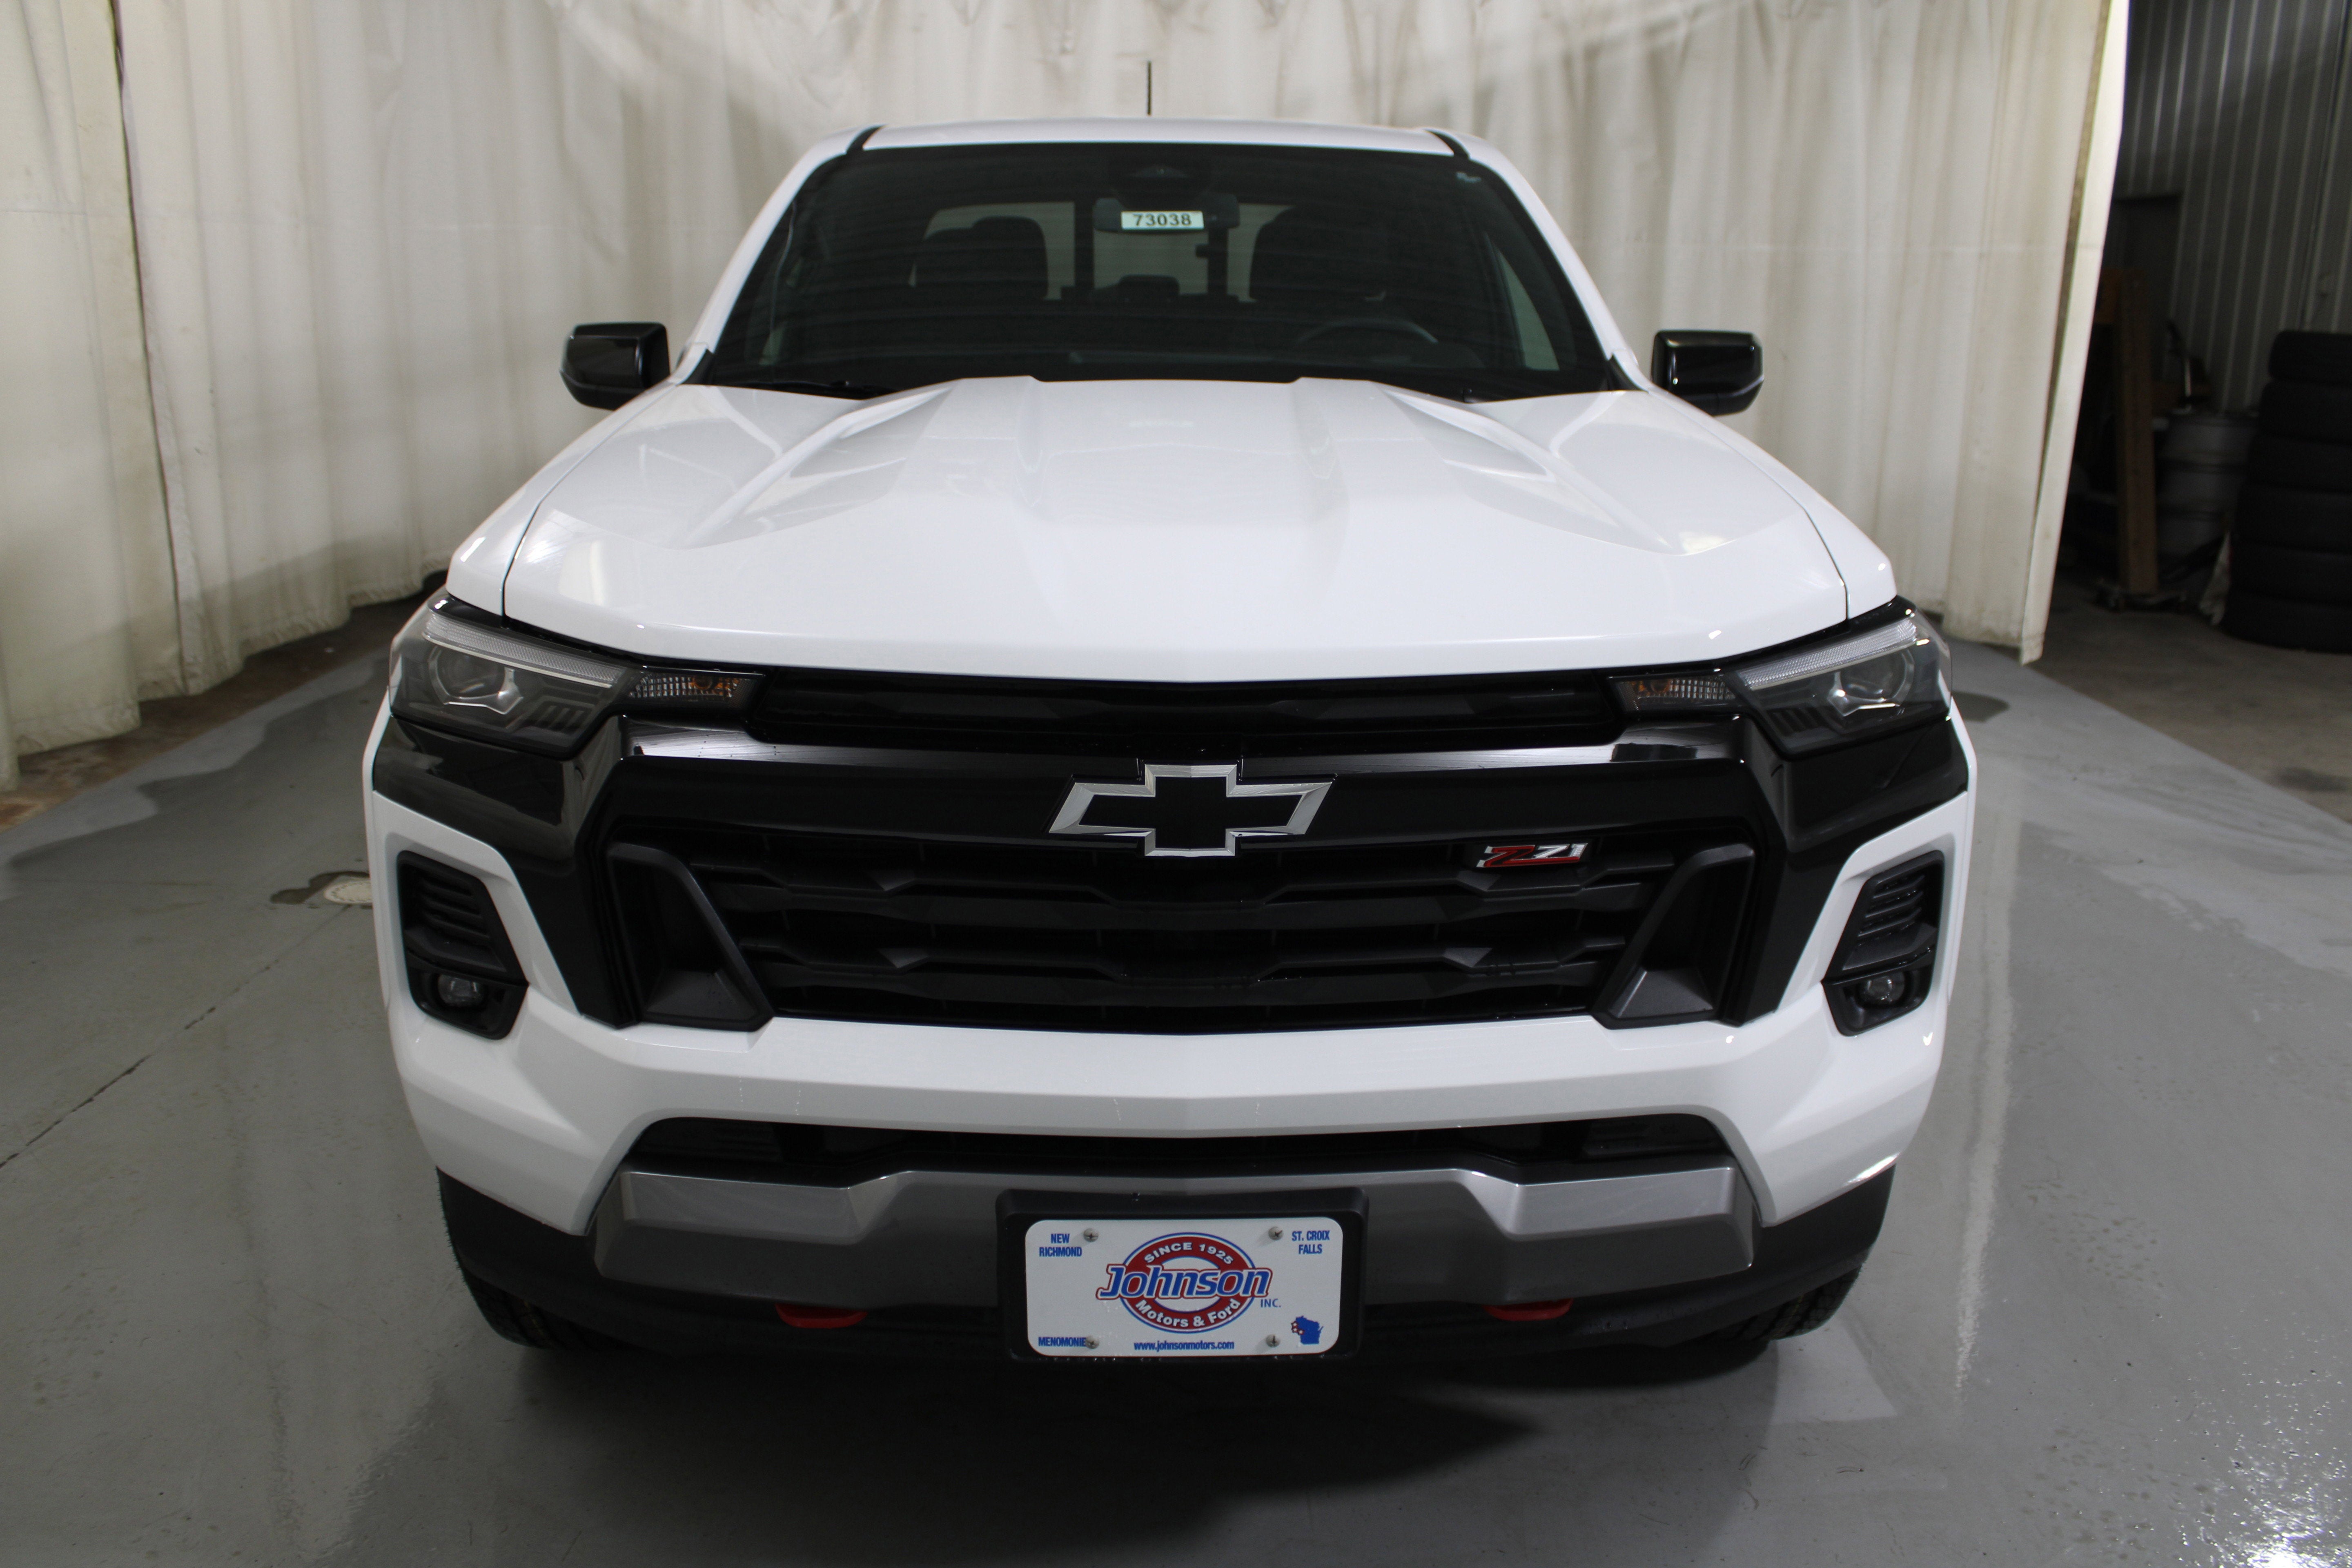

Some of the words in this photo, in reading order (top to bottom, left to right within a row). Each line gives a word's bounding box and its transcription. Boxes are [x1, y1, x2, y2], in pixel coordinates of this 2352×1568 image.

[1133, 212, 1192, 226] 73038
[1476, 843, 1588, 867] Z71
[1051, 1234, 1070, 1243] NEW
[1292, 1231, 1304, 1241] ST.
[1307, 1230, 1330, 1241] CROIX
[1039, 1247, 1082, 1257] RICHMOND
[1144, 1242, 1192, 1263] SINCE
[1199, 1244, 1234, 1265] 1925
[1298, 1244, 1323, 1254] FALLS
[1098, 1265, 1271, 1298] Johnson
[1260, 1298, 1281, 1307] INC.
[1136, 1299, 1189, 1327] Motors
[1193, 1315, 1205, 1327] &
[1207, 1298, 1241, 1323] Ford
[1038, 1337, 1087, 1347] MENOMONIE
[1134, 1340, 1234, 1352] www.johnsonmotors.com
